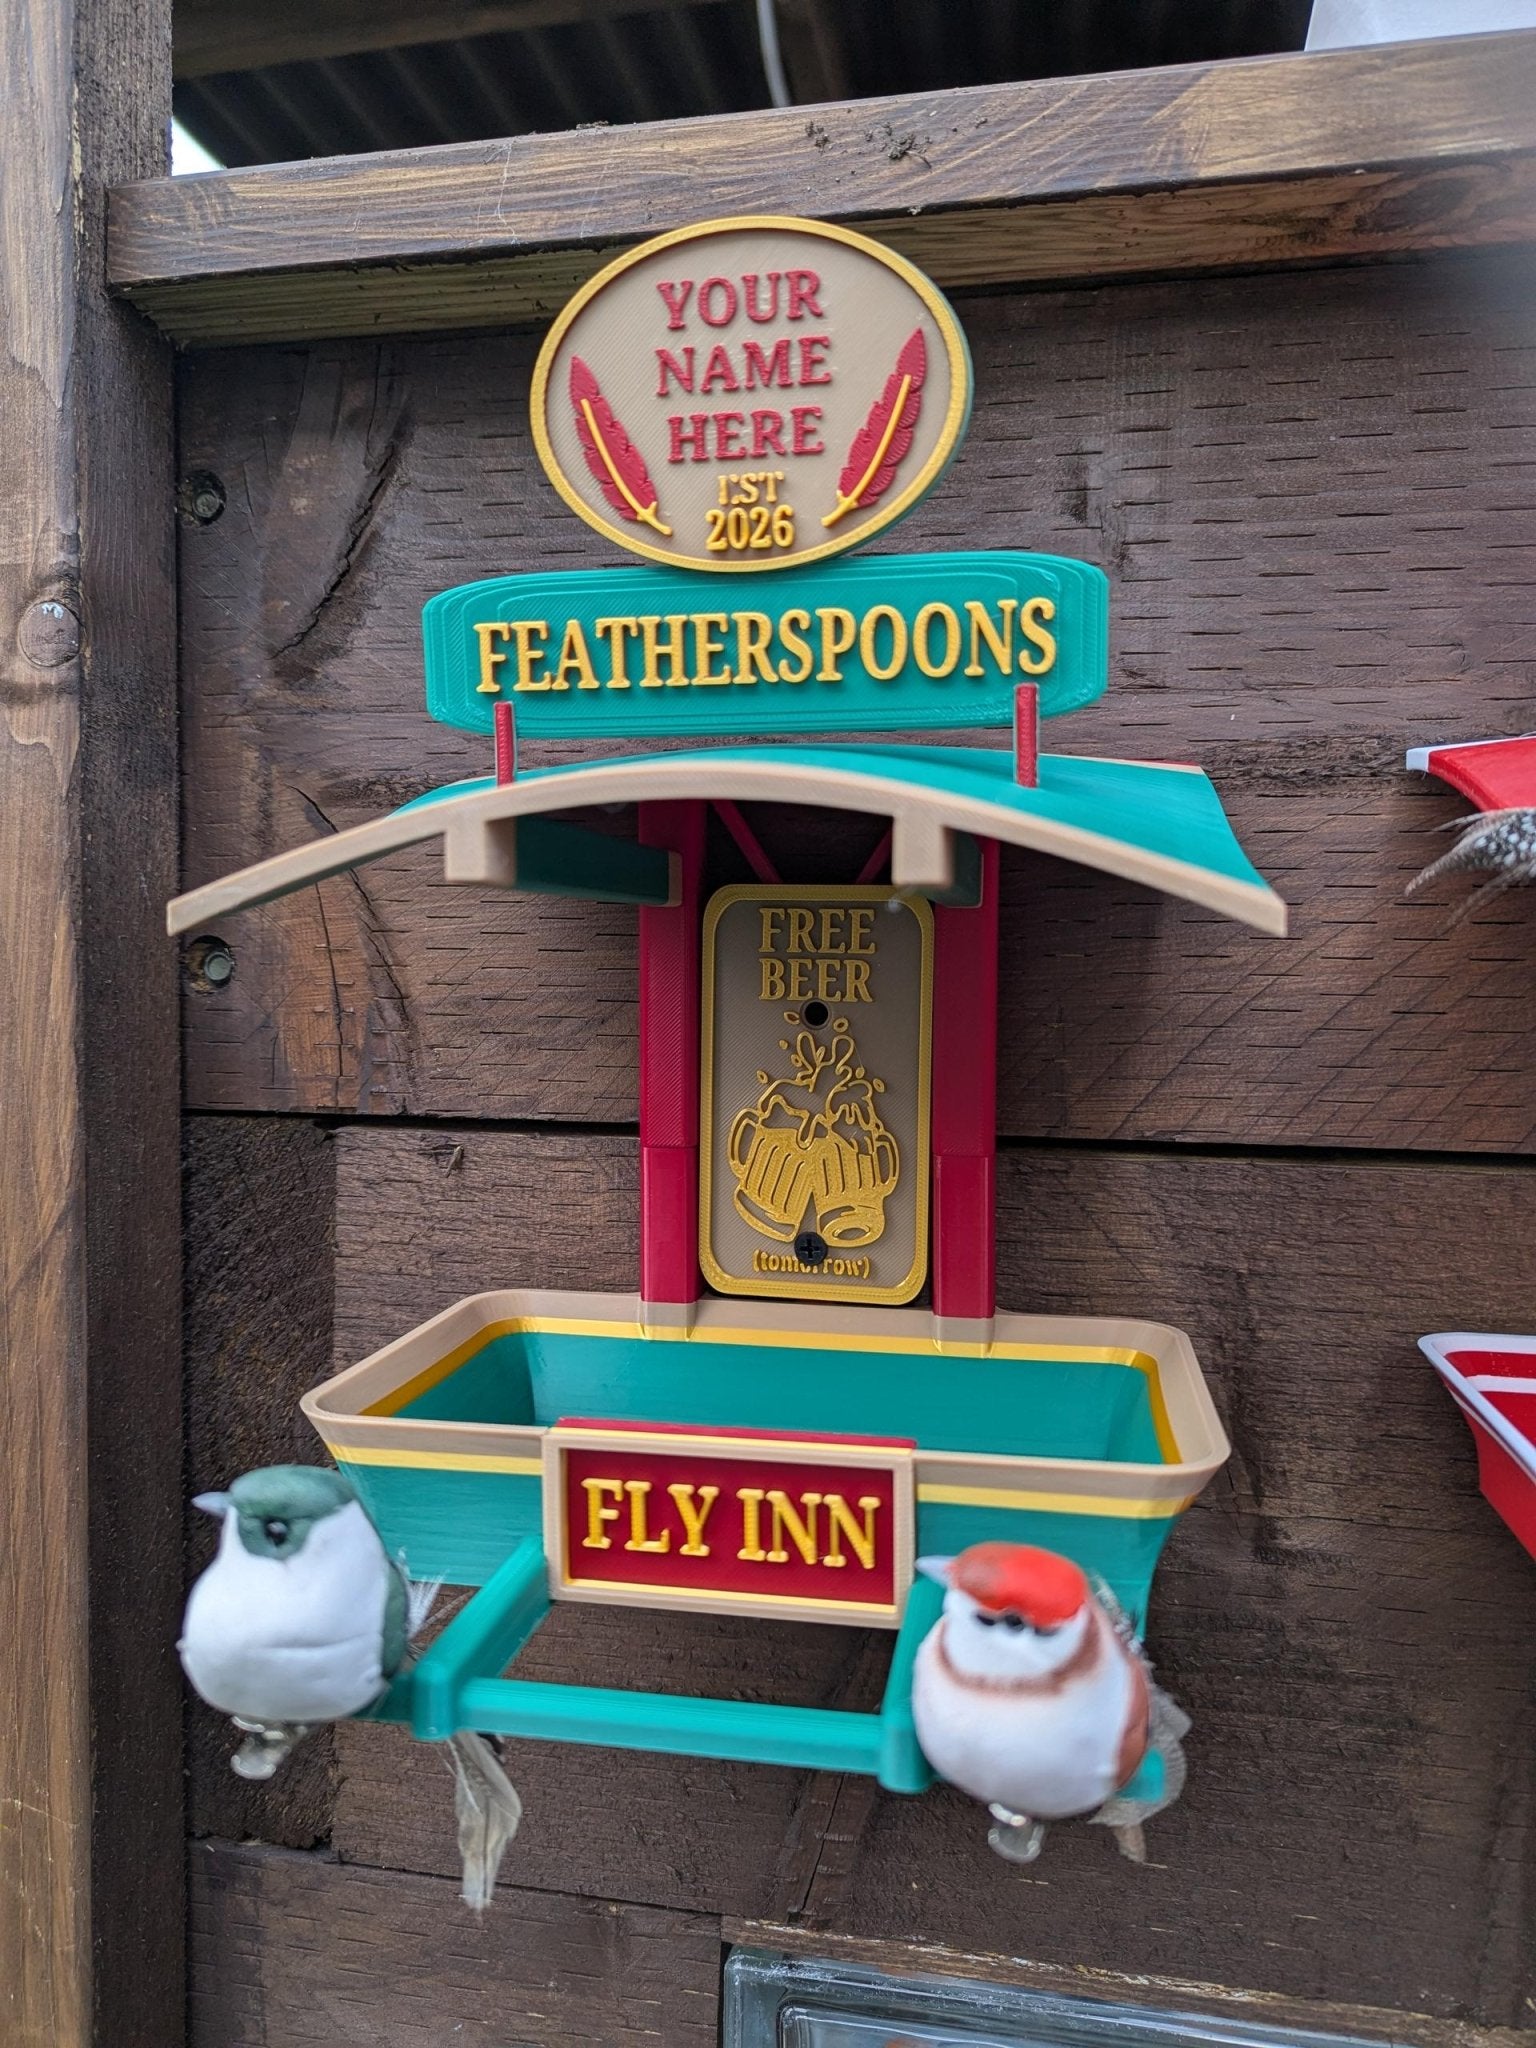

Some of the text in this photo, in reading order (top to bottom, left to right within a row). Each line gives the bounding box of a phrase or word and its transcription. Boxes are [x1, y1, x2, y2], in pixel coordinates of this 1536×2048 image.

[656, 269, 824, 329] YOUR
[655, 335, 831, 396] NAME
[667, 406, 825, 462] HERE
[705, 505, 794, 551] 2026
[473, 597, 1056, 693] FEATHERSPOONS
[758, 907, 876, 954] FREE
[758, 958, 873, 1003] BEER
[581, 1478, 881, 1569] FLY INN
